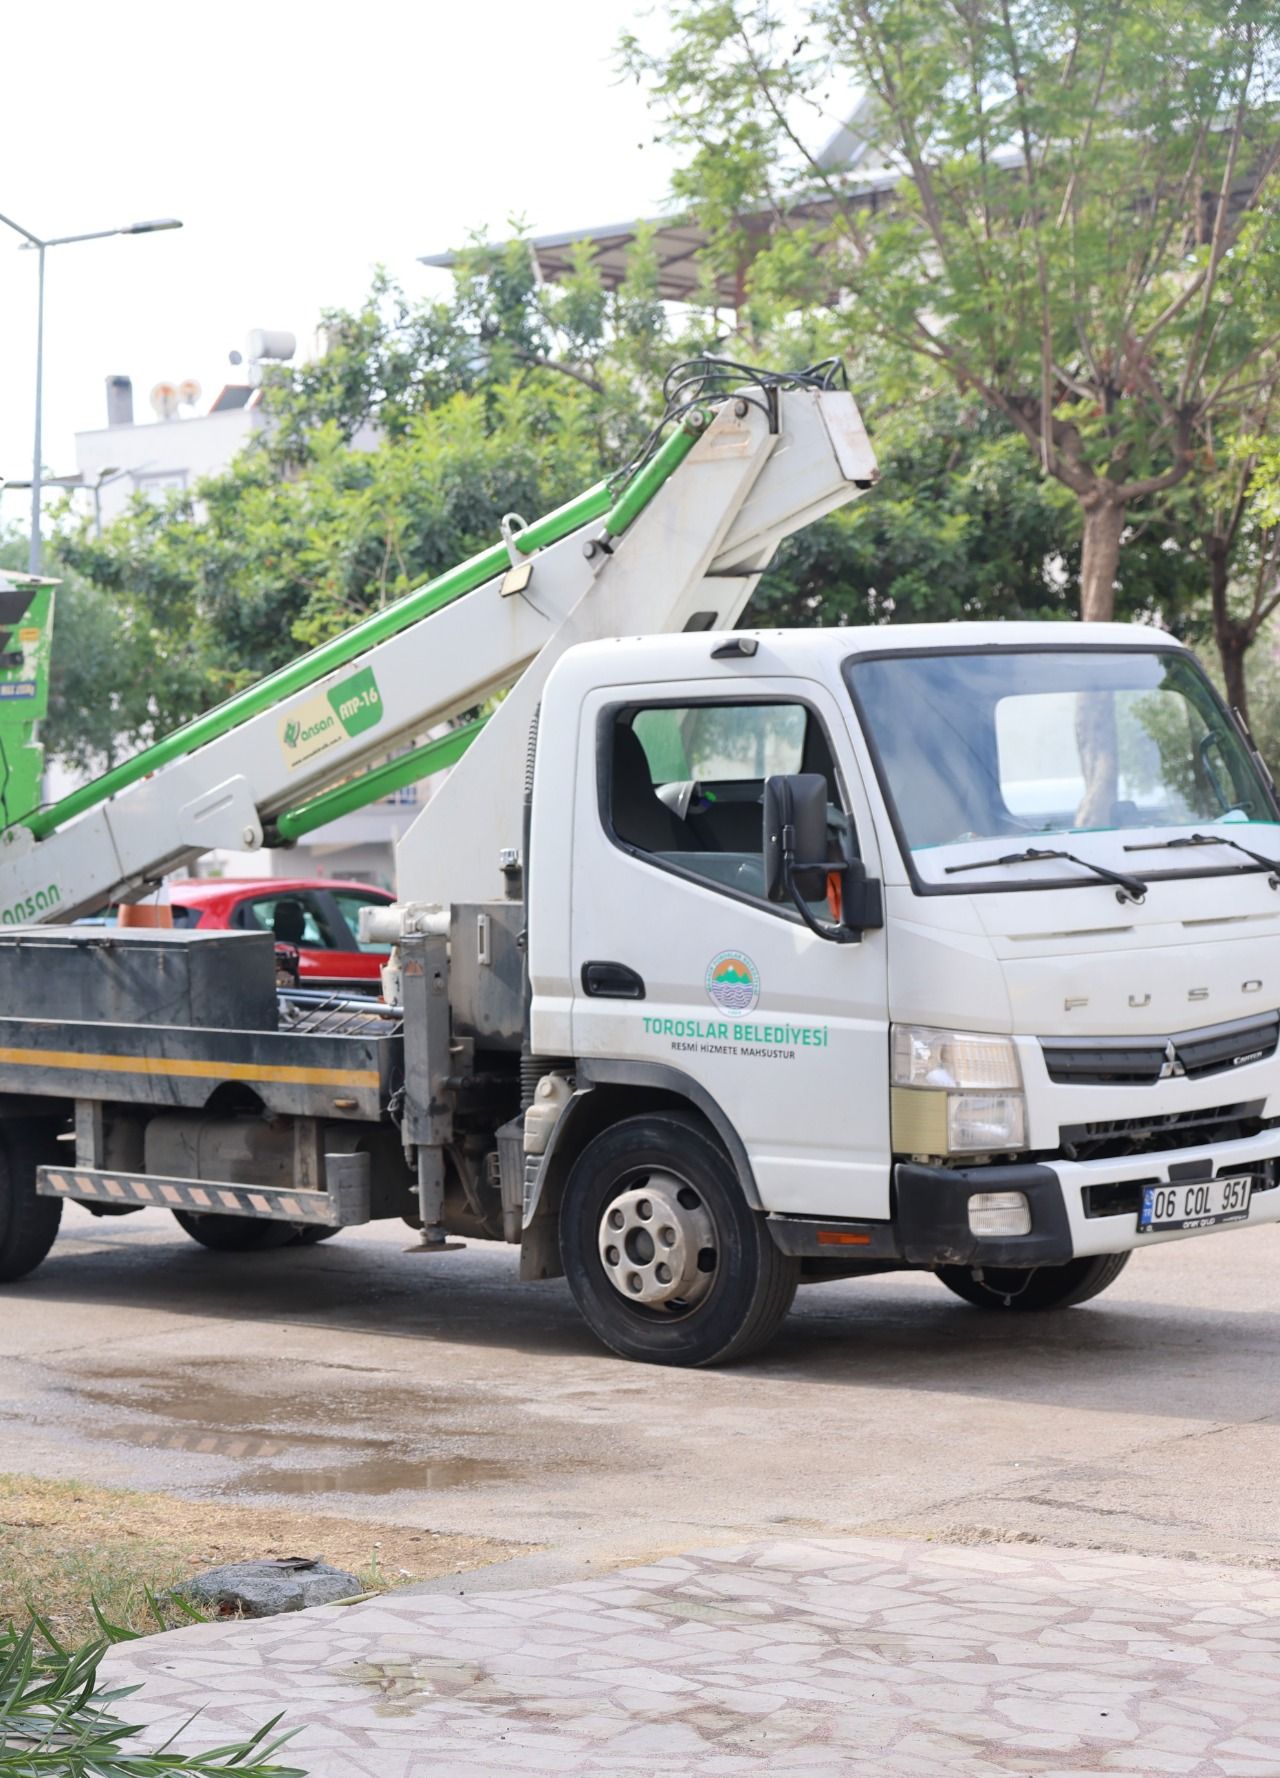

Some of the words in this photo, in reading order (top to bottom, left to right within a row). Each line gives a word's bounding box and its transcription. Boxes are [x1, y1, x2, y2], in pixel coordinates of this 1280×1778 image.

[338, 687, 378, 721] ATP-16
[301, 716, 335, 742] ansan
[2, 884, 61, 925] ansan
[1065, 980, 1263, 1011] FUSO
[642, 1017, 729, 1040] TOROSLAR
[734, 1024, 828, 1047] BELEDİYESİ
[671, 1041, 698, 1052] RESMİ
[700, 1042, 737, 1055] HİZMETE
[740, 1047, 795, 1059] MAHSUSTUR
[1154, 1190, 1177, 1218] 06
[1184, 1186, 1211, 1216] COL
[1222, 1180, 1248, 1210] 951
